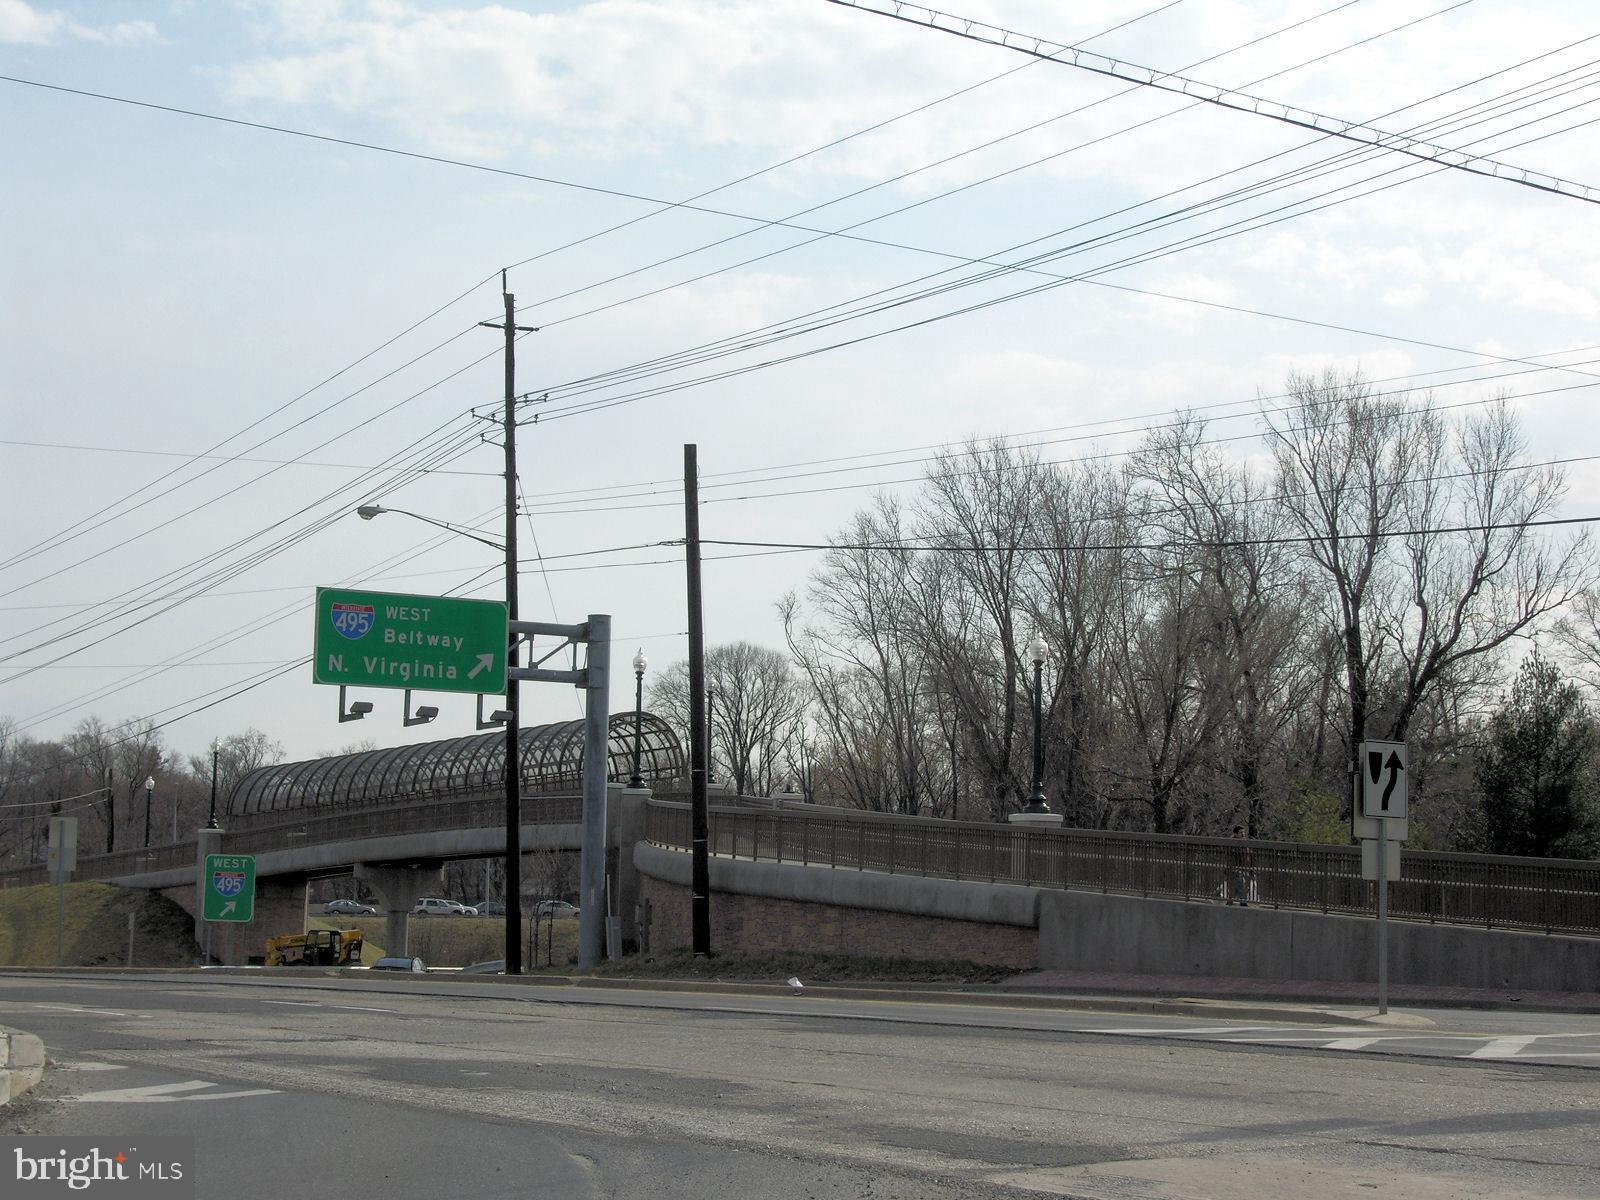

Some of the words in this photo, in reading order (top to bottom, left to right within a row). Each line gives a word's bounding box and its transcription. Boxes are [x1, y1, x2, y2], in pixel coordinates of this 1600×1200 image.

[386, 606, 431, 621] WEST
[336, 613, 369, 633] 495
[384, 629, 464, 651] Beltway
[328, 654, 349, 673] N.
[364, 655, 458, 681] Virginia
[213, 858, 247, 868] WEST
[217, 877, 241, 892] 495
